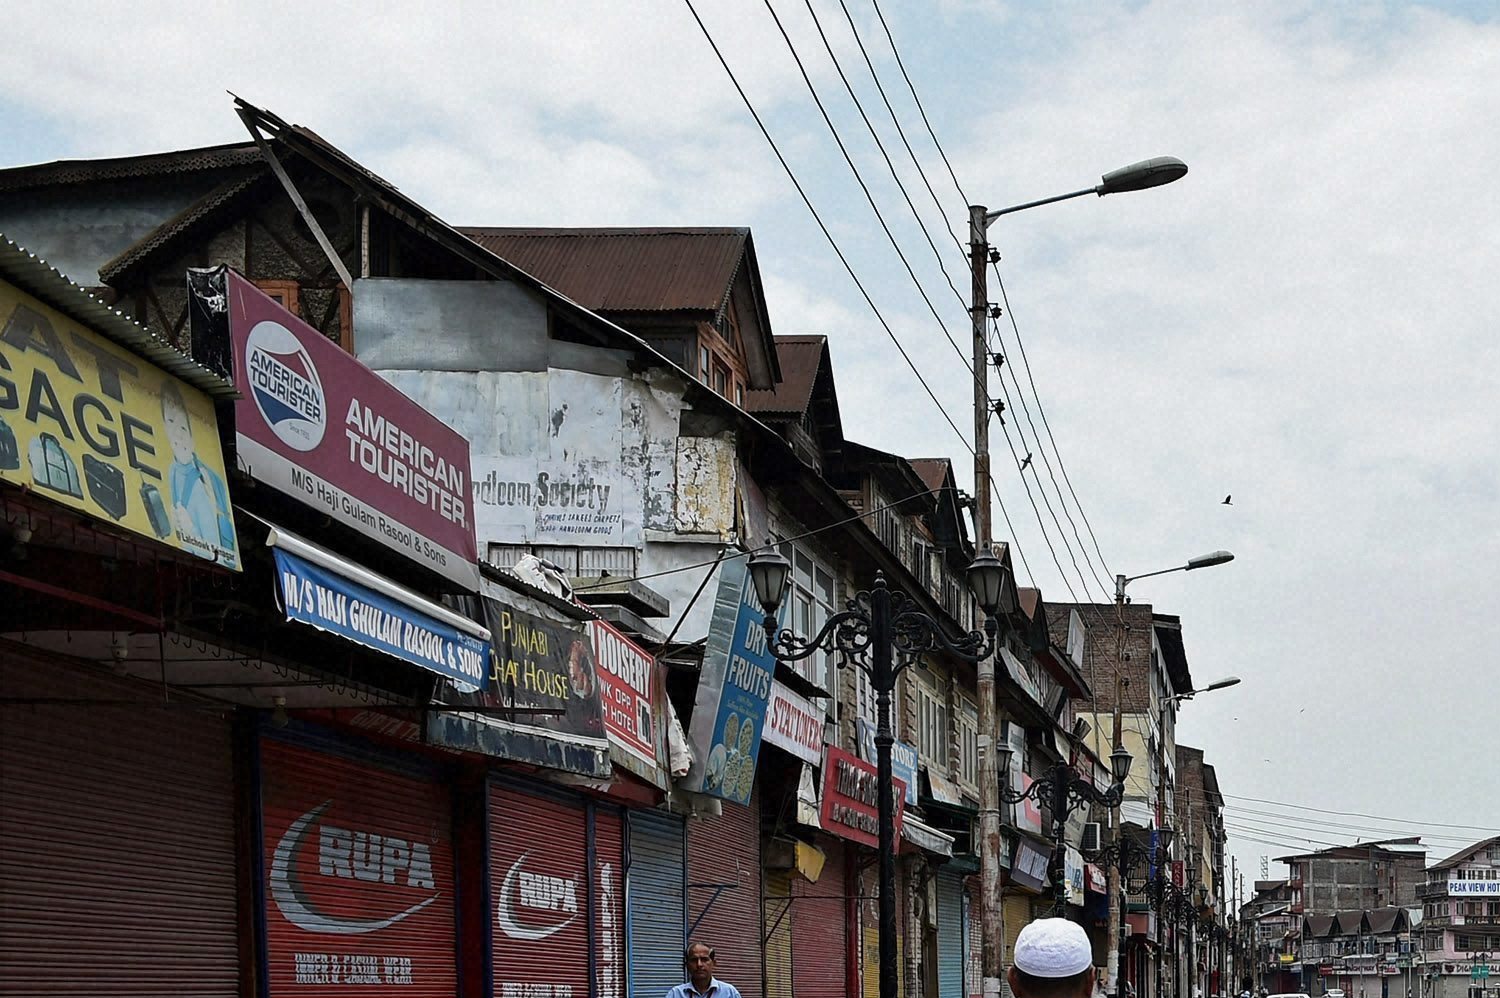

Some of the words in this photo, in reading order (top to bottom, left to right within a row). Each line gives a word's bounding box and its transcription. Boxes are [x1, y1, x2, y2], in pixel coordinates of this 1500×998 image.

[250, 364, 321, 423] TOURISTER
[251, 350, 320, 406] AMERICAN
[345, 398, 463, 497] AMERICAN
[345, 428, 467, 529] TOURISTER
[537, 471, 611, 514] Society
[291, 468, 314, 495] M/S
[317, 481, 339, 512] Haji
[342, 496, 377, 529] Gulam
[379, 517, 412, 546] Rasool
[414, 536, 422, 551] &
[424, 541, 447, 567] Sons
[284, 572, 314, 614] M/S
[316, 584, 348, 627] HAJI
[350, 600, 401, 648] GHULAM
[404, 623, 446, 666] RASOOL
[447, 642, 457, 671] &
[457, 646, 483, 681] SONS
[501, 611, 549, 657] PUNJABI
[744, 619, 768, 658] DRY
[524, 659, 570, 700] HOUSE
[597, 624, 651, 699] HOISERY
[727, 656, 769, 701] FRUITS
[611, 709, 637, 735] HOTEL
[615, 688, 633, 713] OPP.
[319, 825, 435, 890] RUPA
[520, 871, 578, 913] RUPA
[1449, 882, 1467, 892] PEAK
[1468, 882, 1485, 892] VIEW
